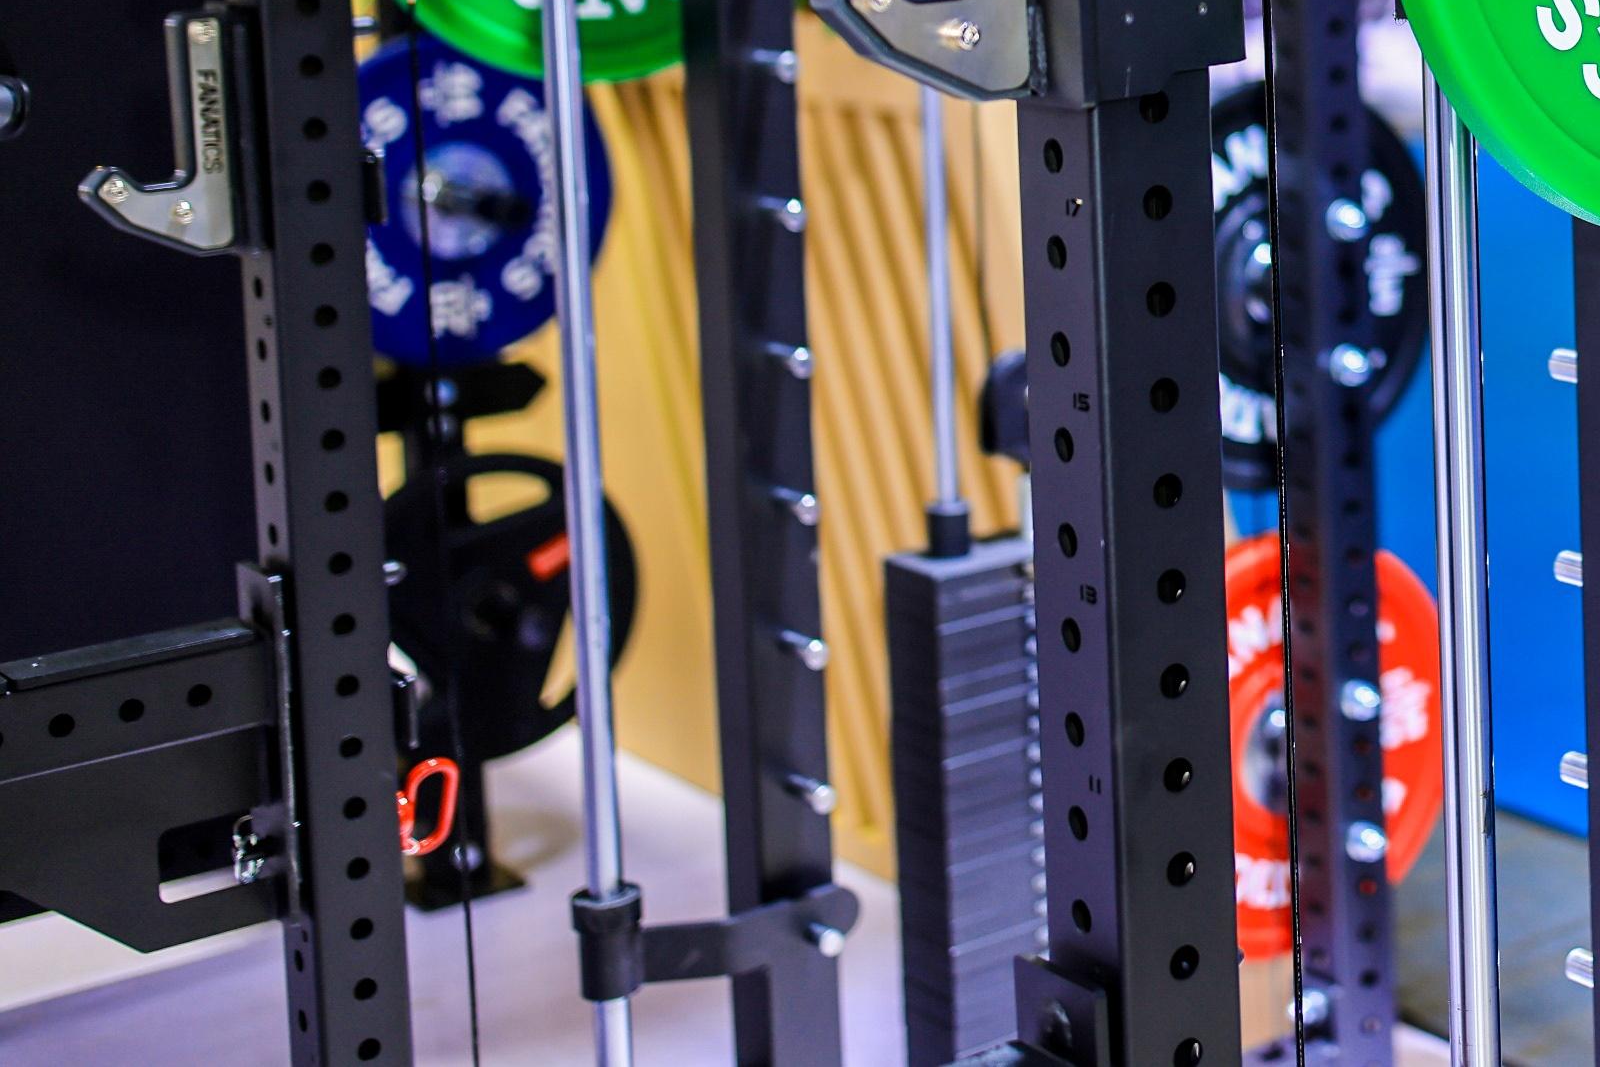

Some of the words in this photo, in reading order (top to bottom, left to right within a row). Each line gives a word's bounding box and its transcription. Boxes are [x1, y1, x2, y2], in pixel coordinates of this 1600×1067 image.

[197, 68, 224, 174] FANATICS
[1064, 197, 1084, 218] 17
[1072, 392, 1091, 413] 15
